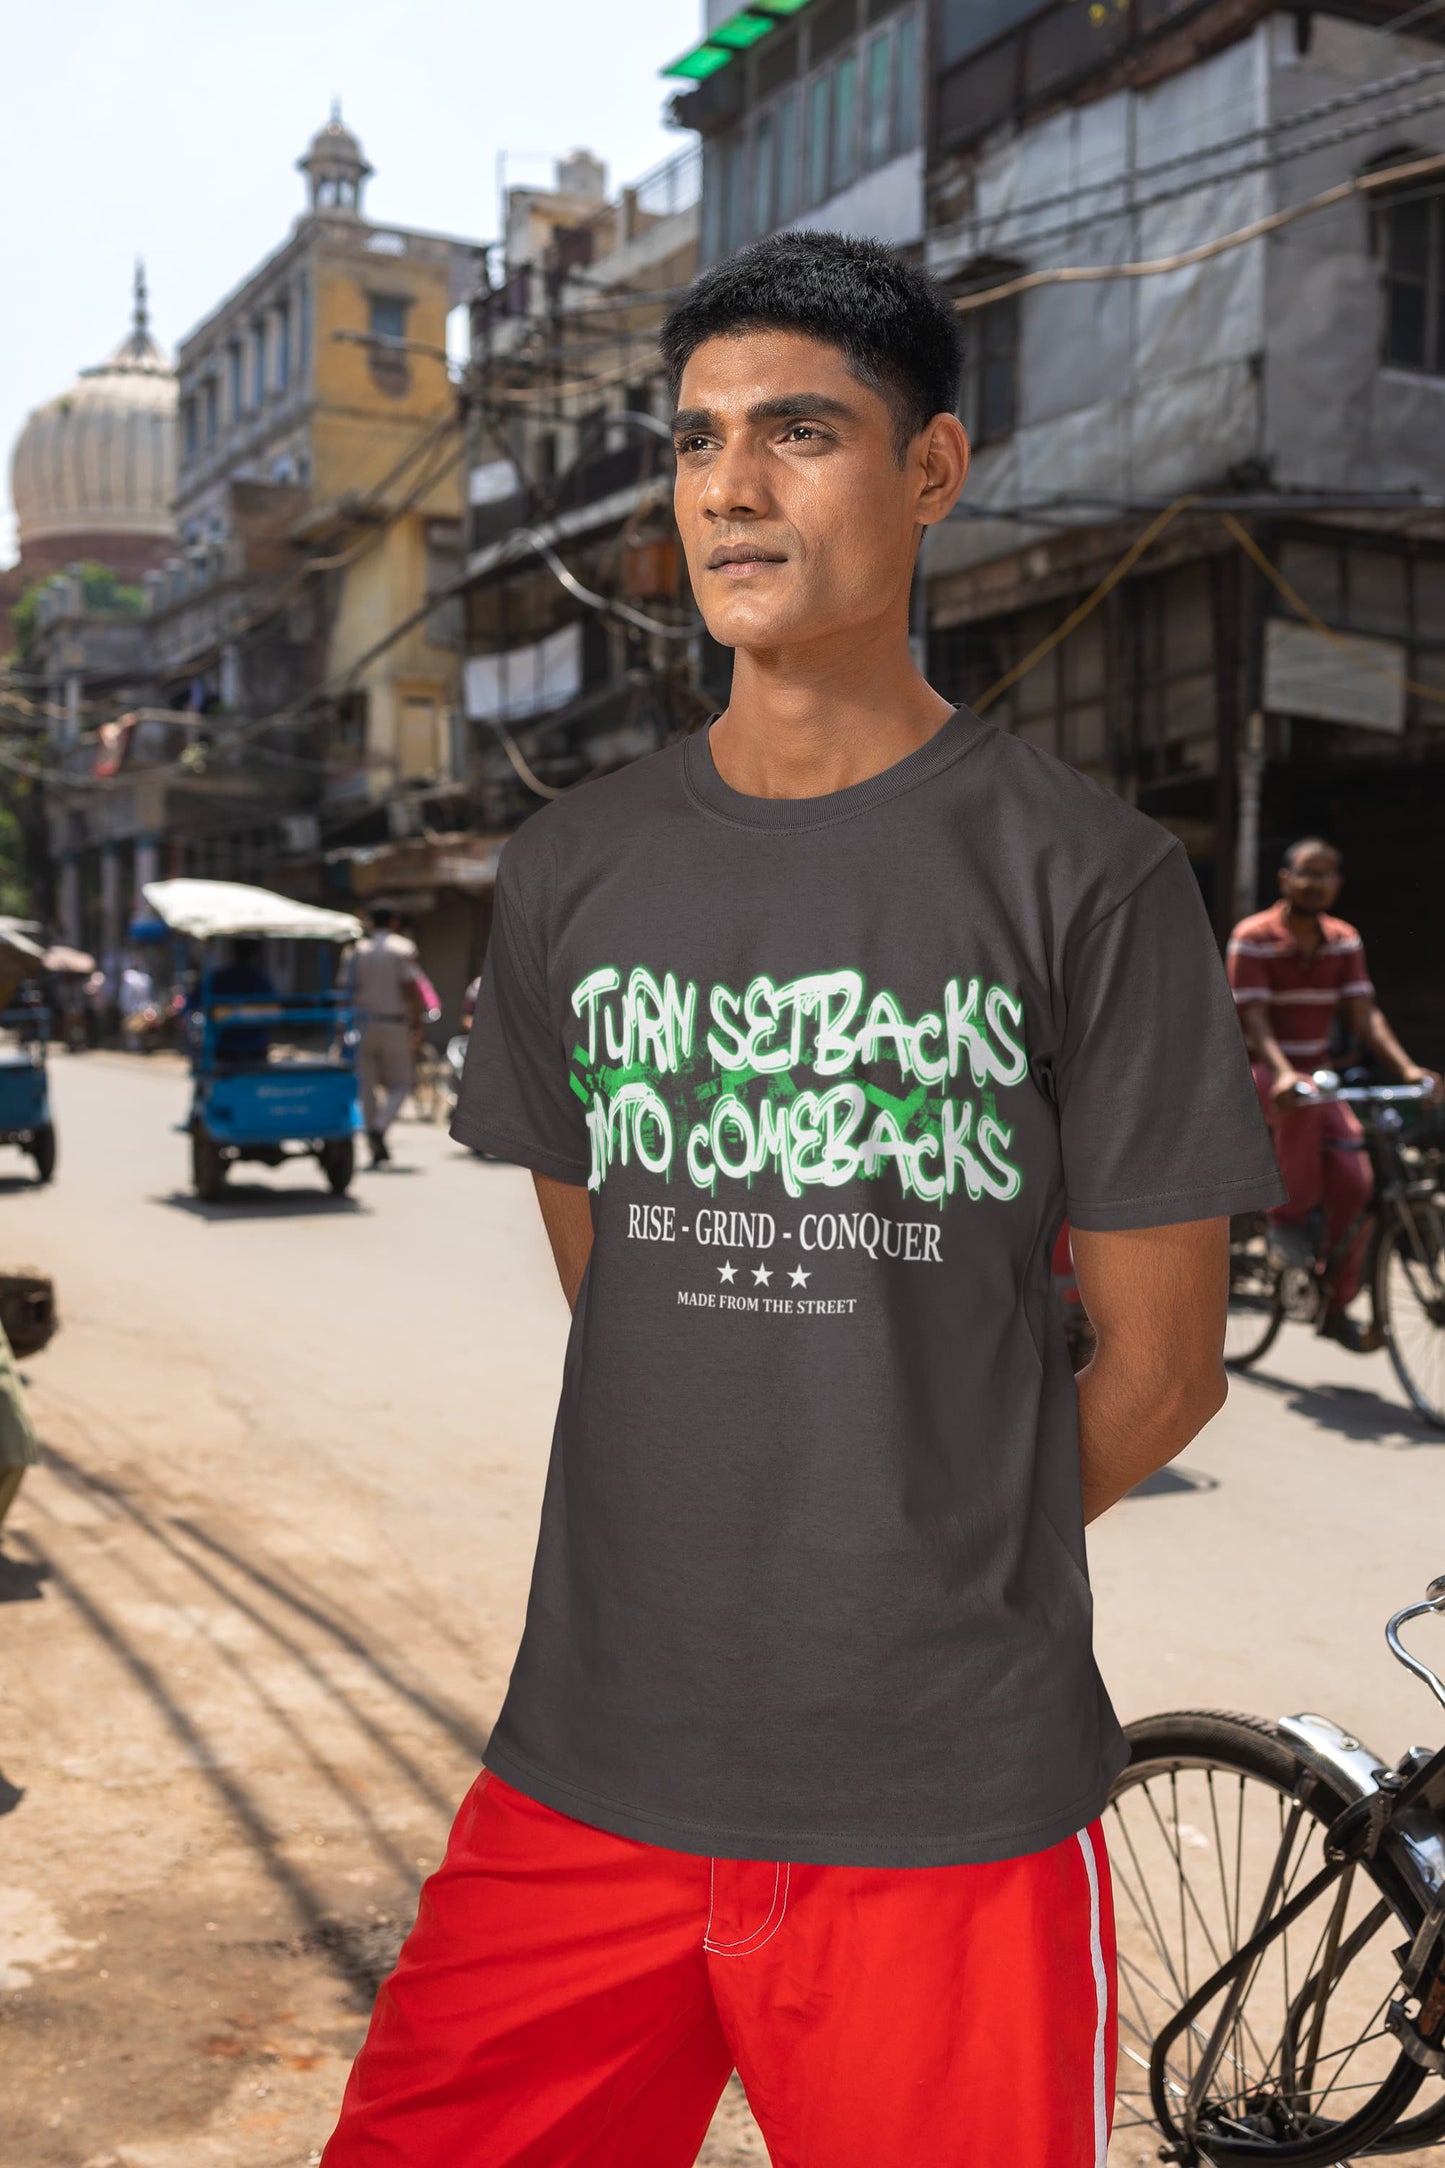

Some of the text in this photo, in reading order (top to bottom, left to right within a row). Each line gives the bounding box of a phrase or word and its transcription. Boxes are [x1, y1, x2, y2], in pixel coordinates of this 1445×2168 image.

[627, 1203, 676, 1242] RISE
[695, 1208, 776, 1249] GRIND
[799, 1212, 943, 1262] CONQUER
[677, 1291, 857, 1315] MADE FROM THE STREET
